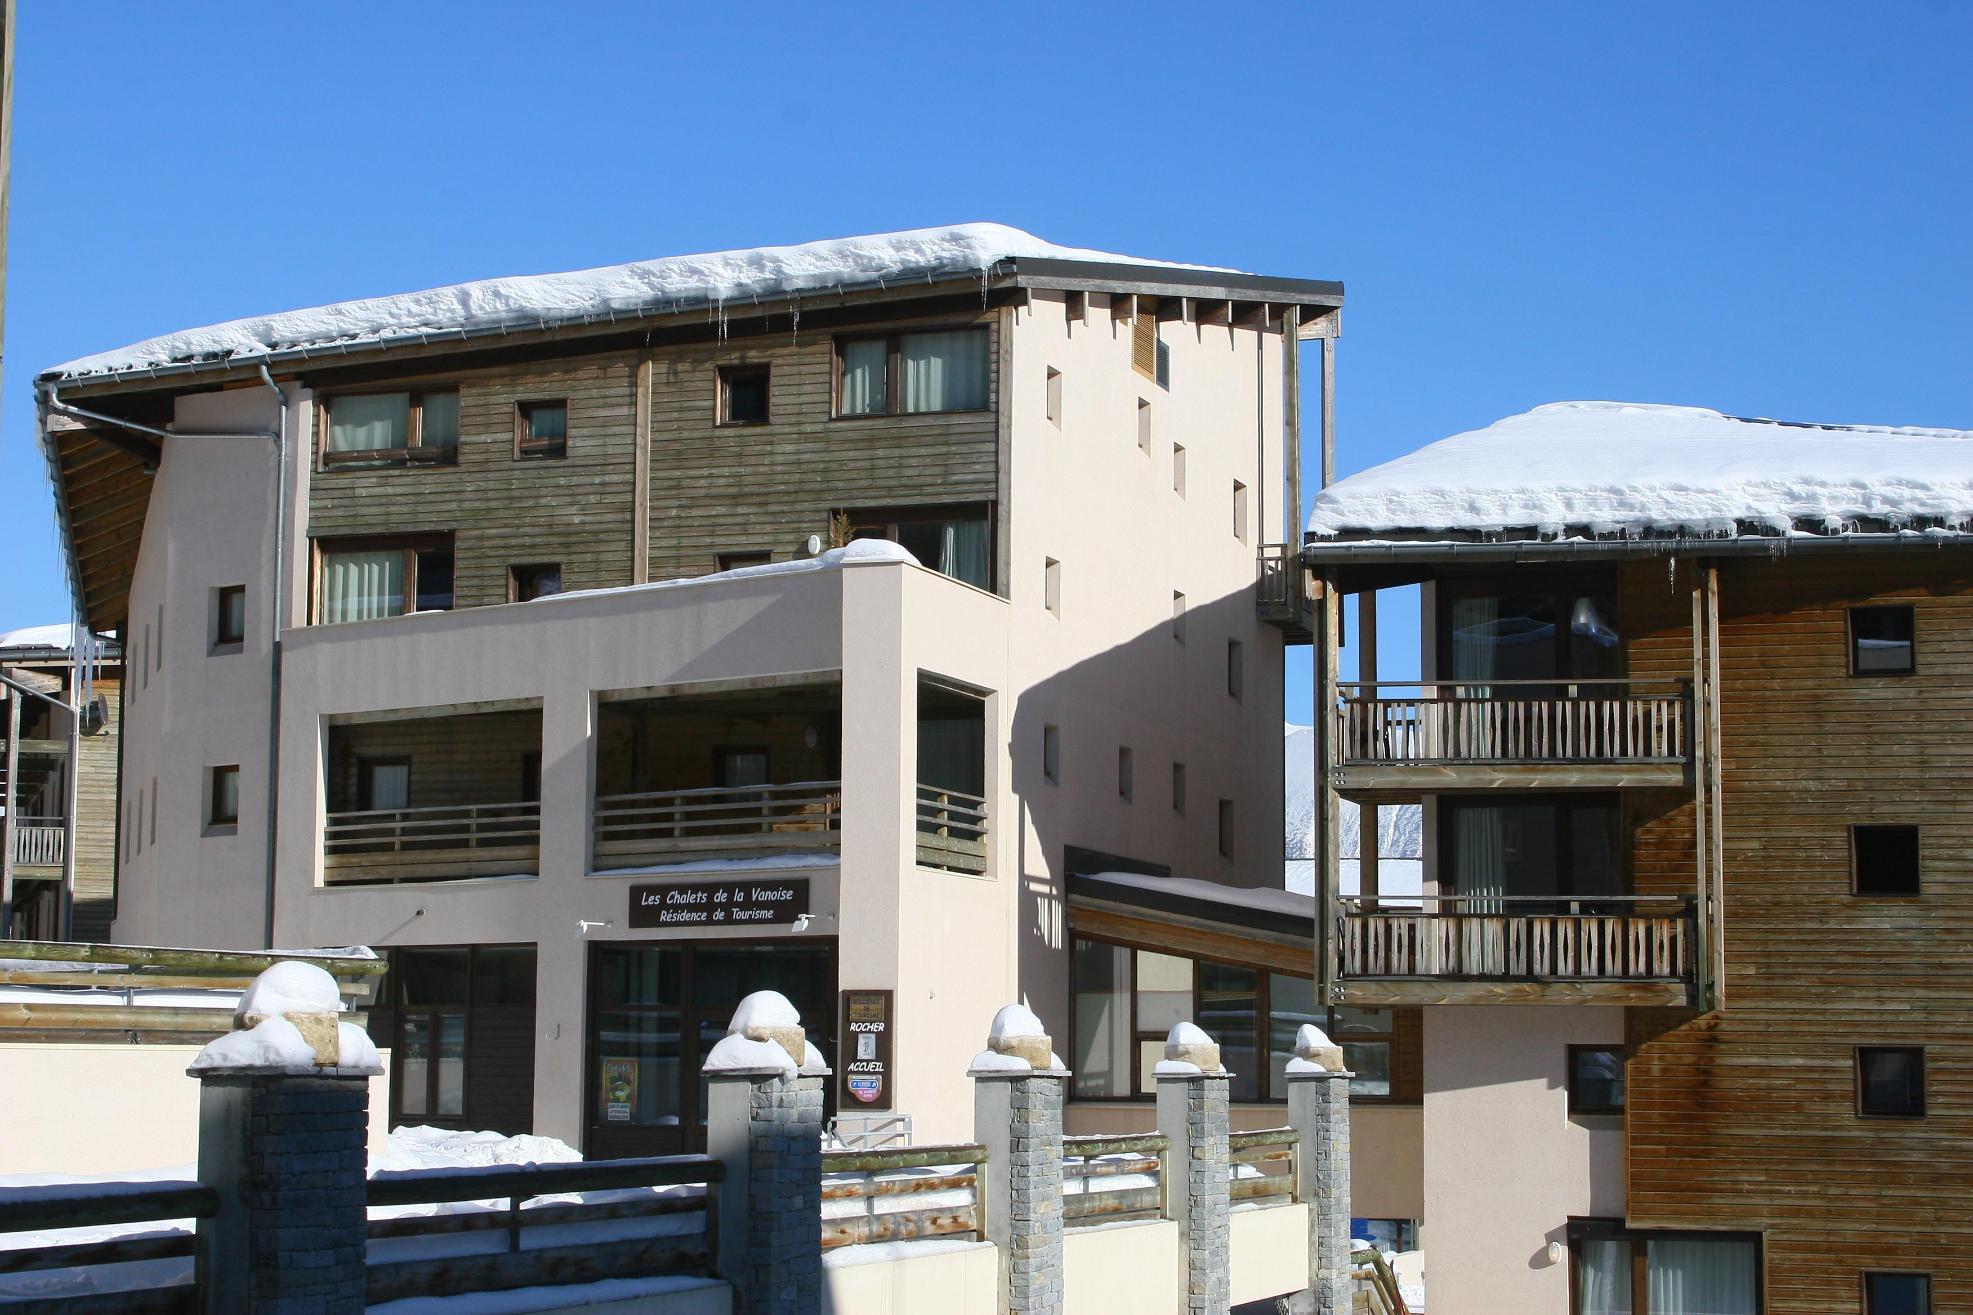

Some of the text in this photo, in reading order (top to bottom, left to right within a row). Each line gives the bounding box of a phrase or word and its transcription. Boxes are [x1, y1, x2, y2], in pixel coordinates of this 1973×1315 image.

[641, 887, 793, 905] Les Chalets de la Vanoise
[660, 908, 774, 922] Résidence de Tourisme
[850, 1022, 885, 1032] ROCHER
[847, 1061, 884, 1072] ACCUEIL
